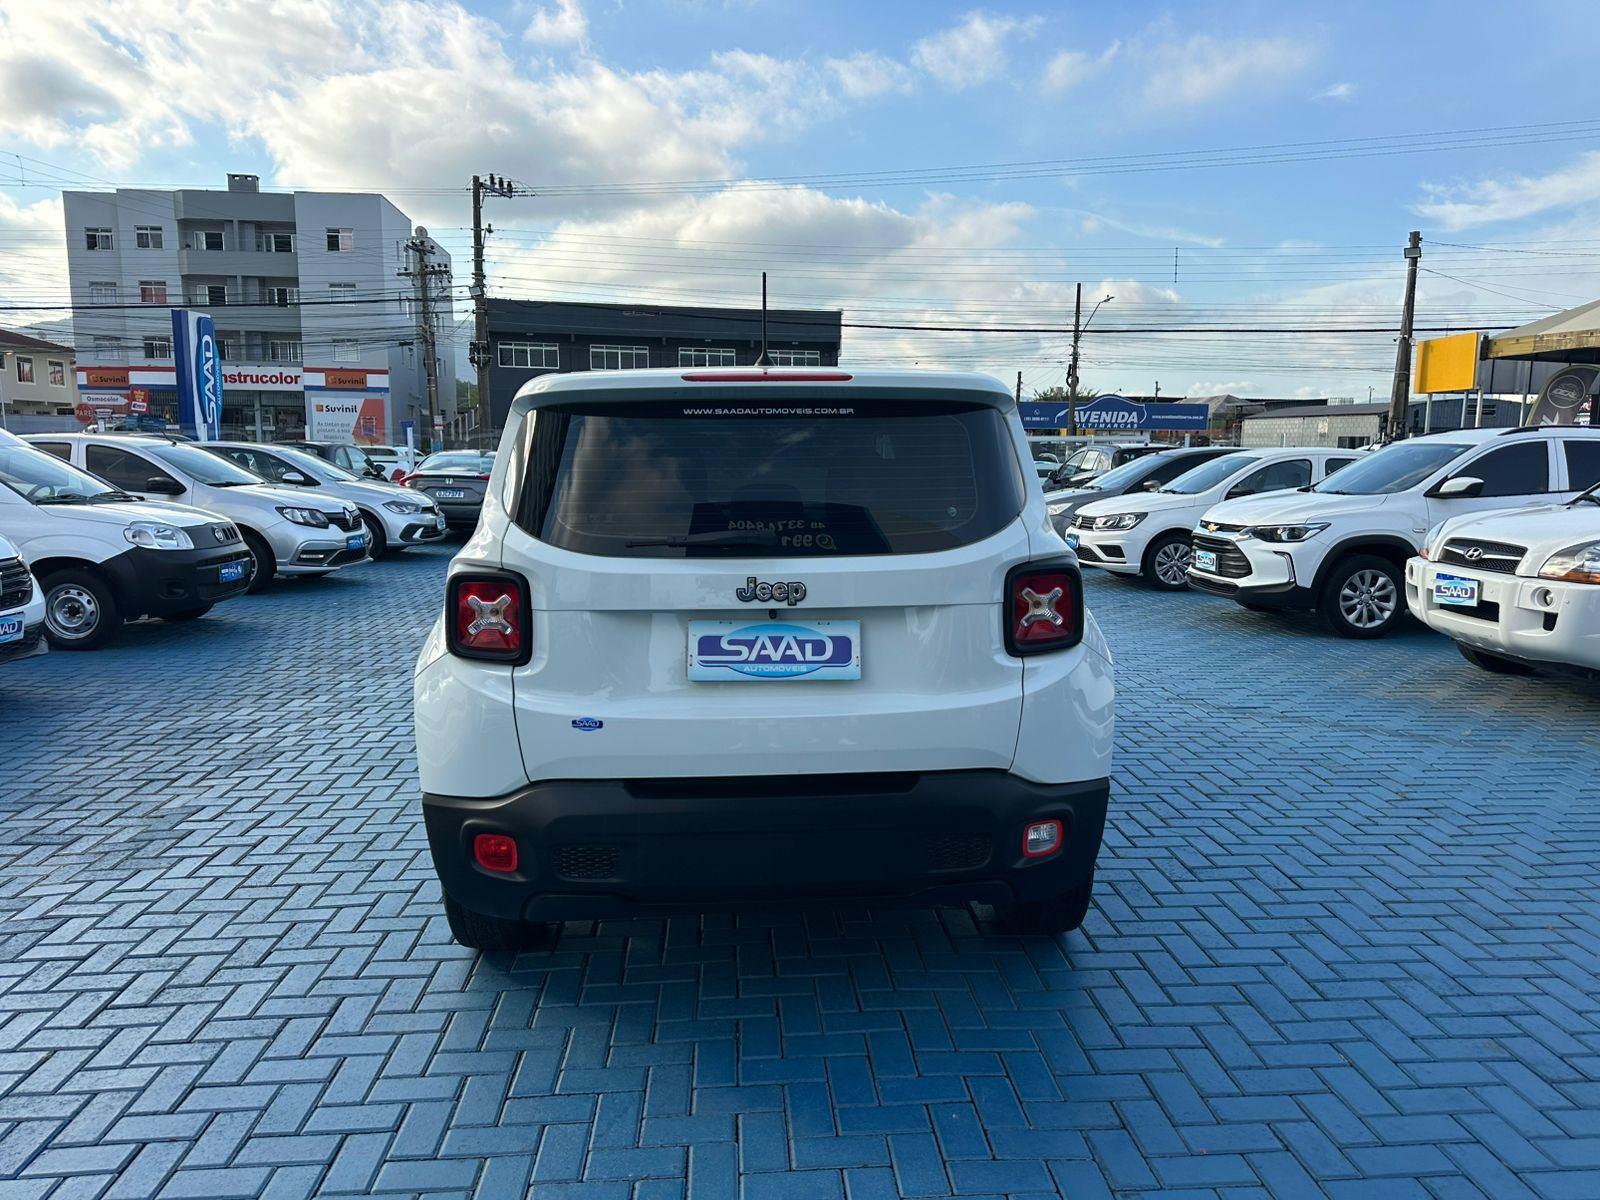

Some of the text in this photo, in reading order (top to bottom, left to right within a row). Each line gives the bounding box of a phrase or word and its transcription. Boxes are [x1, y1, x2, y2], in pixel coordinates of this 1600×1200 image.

[99, 375, 127, 383] Suvinil
[337, 377, 365, 385] Suvinil
[202, 334, 219, 439] SAAD
[325, 404, 358, 413] Suvinil
[683, 407, 855, 415] WWW.SAADAUTOMOVEIS.COM.BR
[1074, 410, 1138, 423] AVENIDA
[736, 577, 806, 606] Jeep
[1435, 585, 1470, 598] SAAD
[698, 635, 834, 662] SAAD
